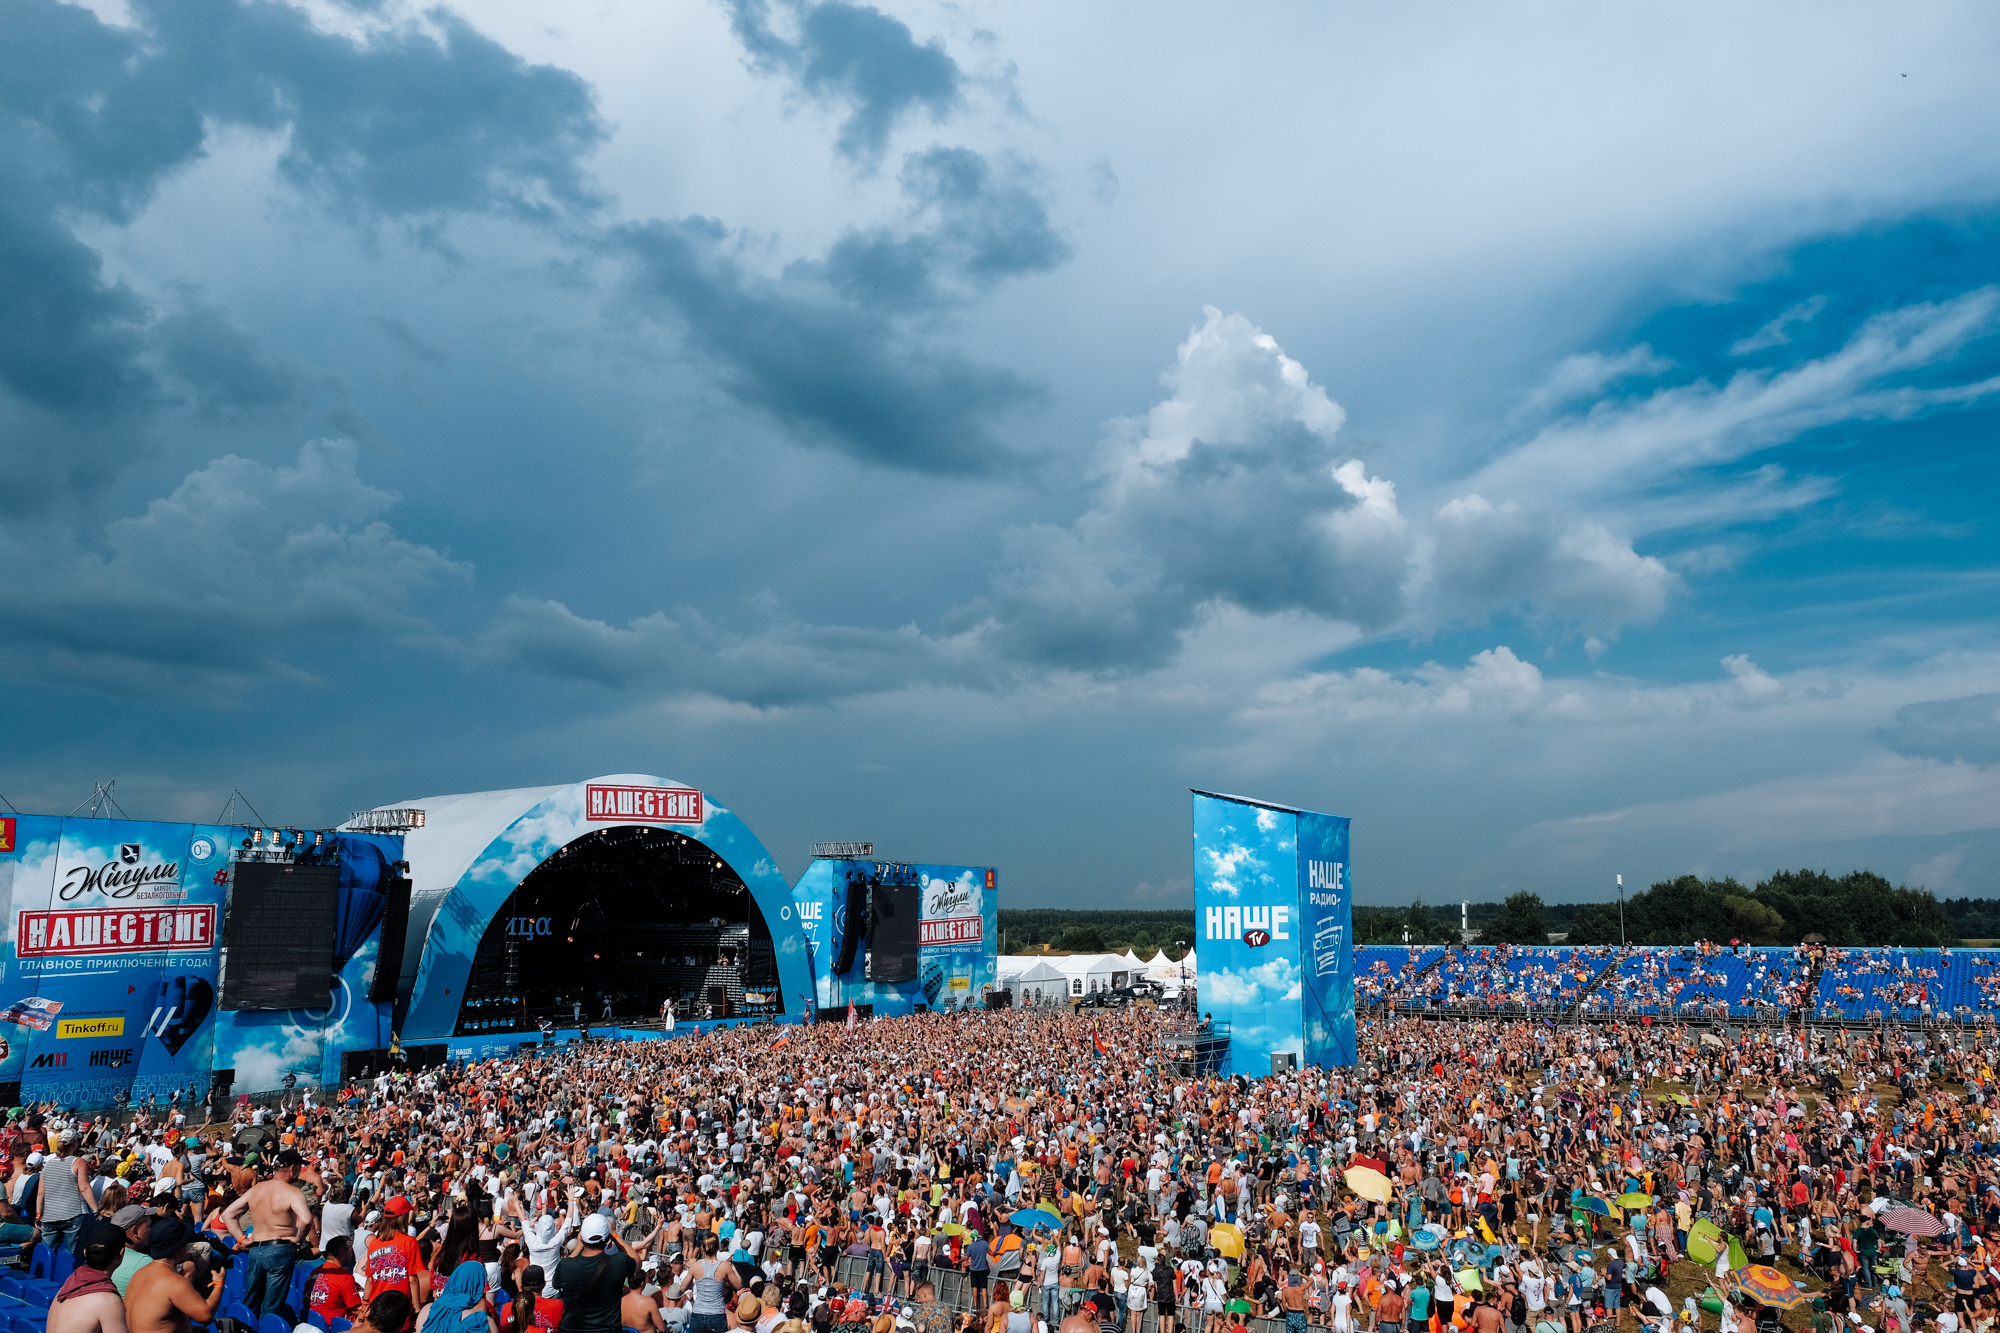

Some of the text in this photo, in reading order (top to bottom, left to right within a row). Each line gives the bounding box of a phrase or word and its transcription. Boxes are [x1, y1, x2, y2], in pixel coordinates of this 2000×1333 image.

[592, 791, 697, 817] НАШЕСТВИЕ
[60, 861, 180, 901] Жигули
[1309, 860, 1343, 889] НАШЕ
[136, 891, 188, 900] БЕЗАЛКОГОЛЬНОЕ
[930, 891, 969, 915] Жигули
[1310, 893, 1337, 907] РАДИО
[28, 912, 206, 949] НАШЕСТВИЕ
[921, 920, 979, 941] НАШЕСТВИЕ
[1206, 906, 1289, 940] НАШЕ
[1249, 931, 1265, 946] TV
[19, 957, 212, 970] ГЛАВНОЕ ПРИКЛЮЧЕНИЕ ГОДА!
[64, 1022, 119, 1034] Tinkoff.ru
[29, 1052, 68, 1068] М11
[89, 1048, 133, 1066] НАШЕ
[33, 1082, 60, 1093] ПИВО
[100, 1076, 131, 1088] БАРНОЕ
